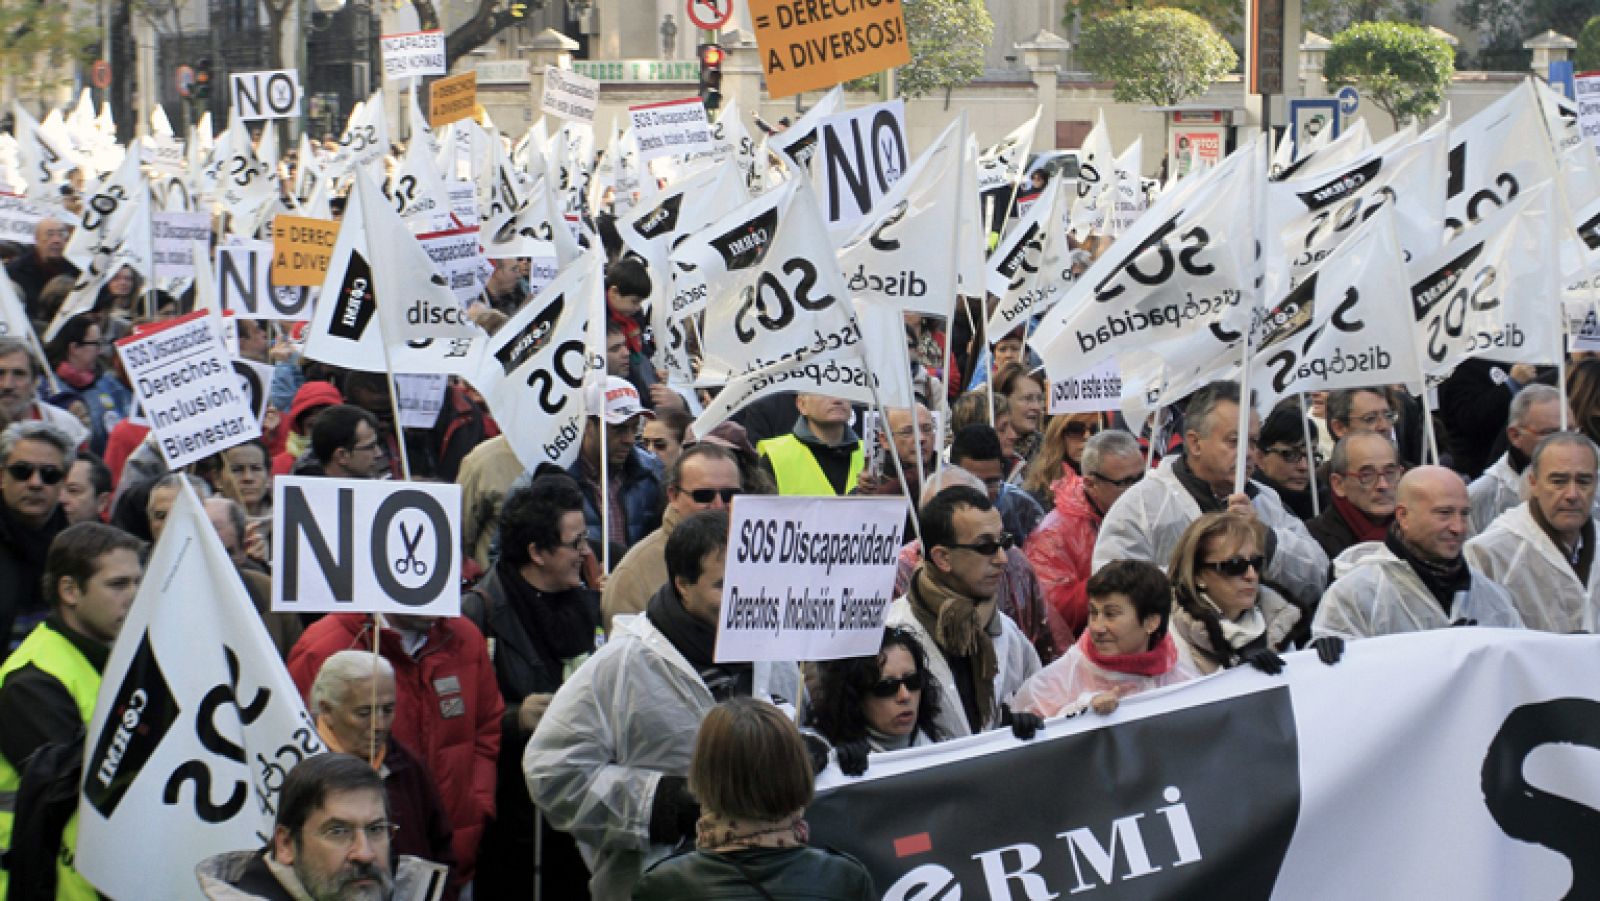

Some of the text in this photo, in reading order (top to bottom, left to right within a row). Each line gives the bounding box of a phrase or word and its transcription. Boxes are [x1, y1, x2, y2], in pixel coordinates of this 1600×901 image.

[777, 0, 895, 29] DERECH
[768, 16, 903, 74] A DIVERSOS!
[236, 73, 295, 117] NO
[823, 109, 907, 222] NO
[276, 250, 331, 272] A DIVE
[138, 357, 229, 399] Derechos,
[149, 386, 240, 430] Inclusión,
[163, 416, 252, 460] Bienestar.
[283, 486, 453, 608] NO
[736, 518, 900, 576] SOS Discapacidad:
[726, 585, 780, 638] Derechos,
[783, 585, 836, 638] Inclusión,
